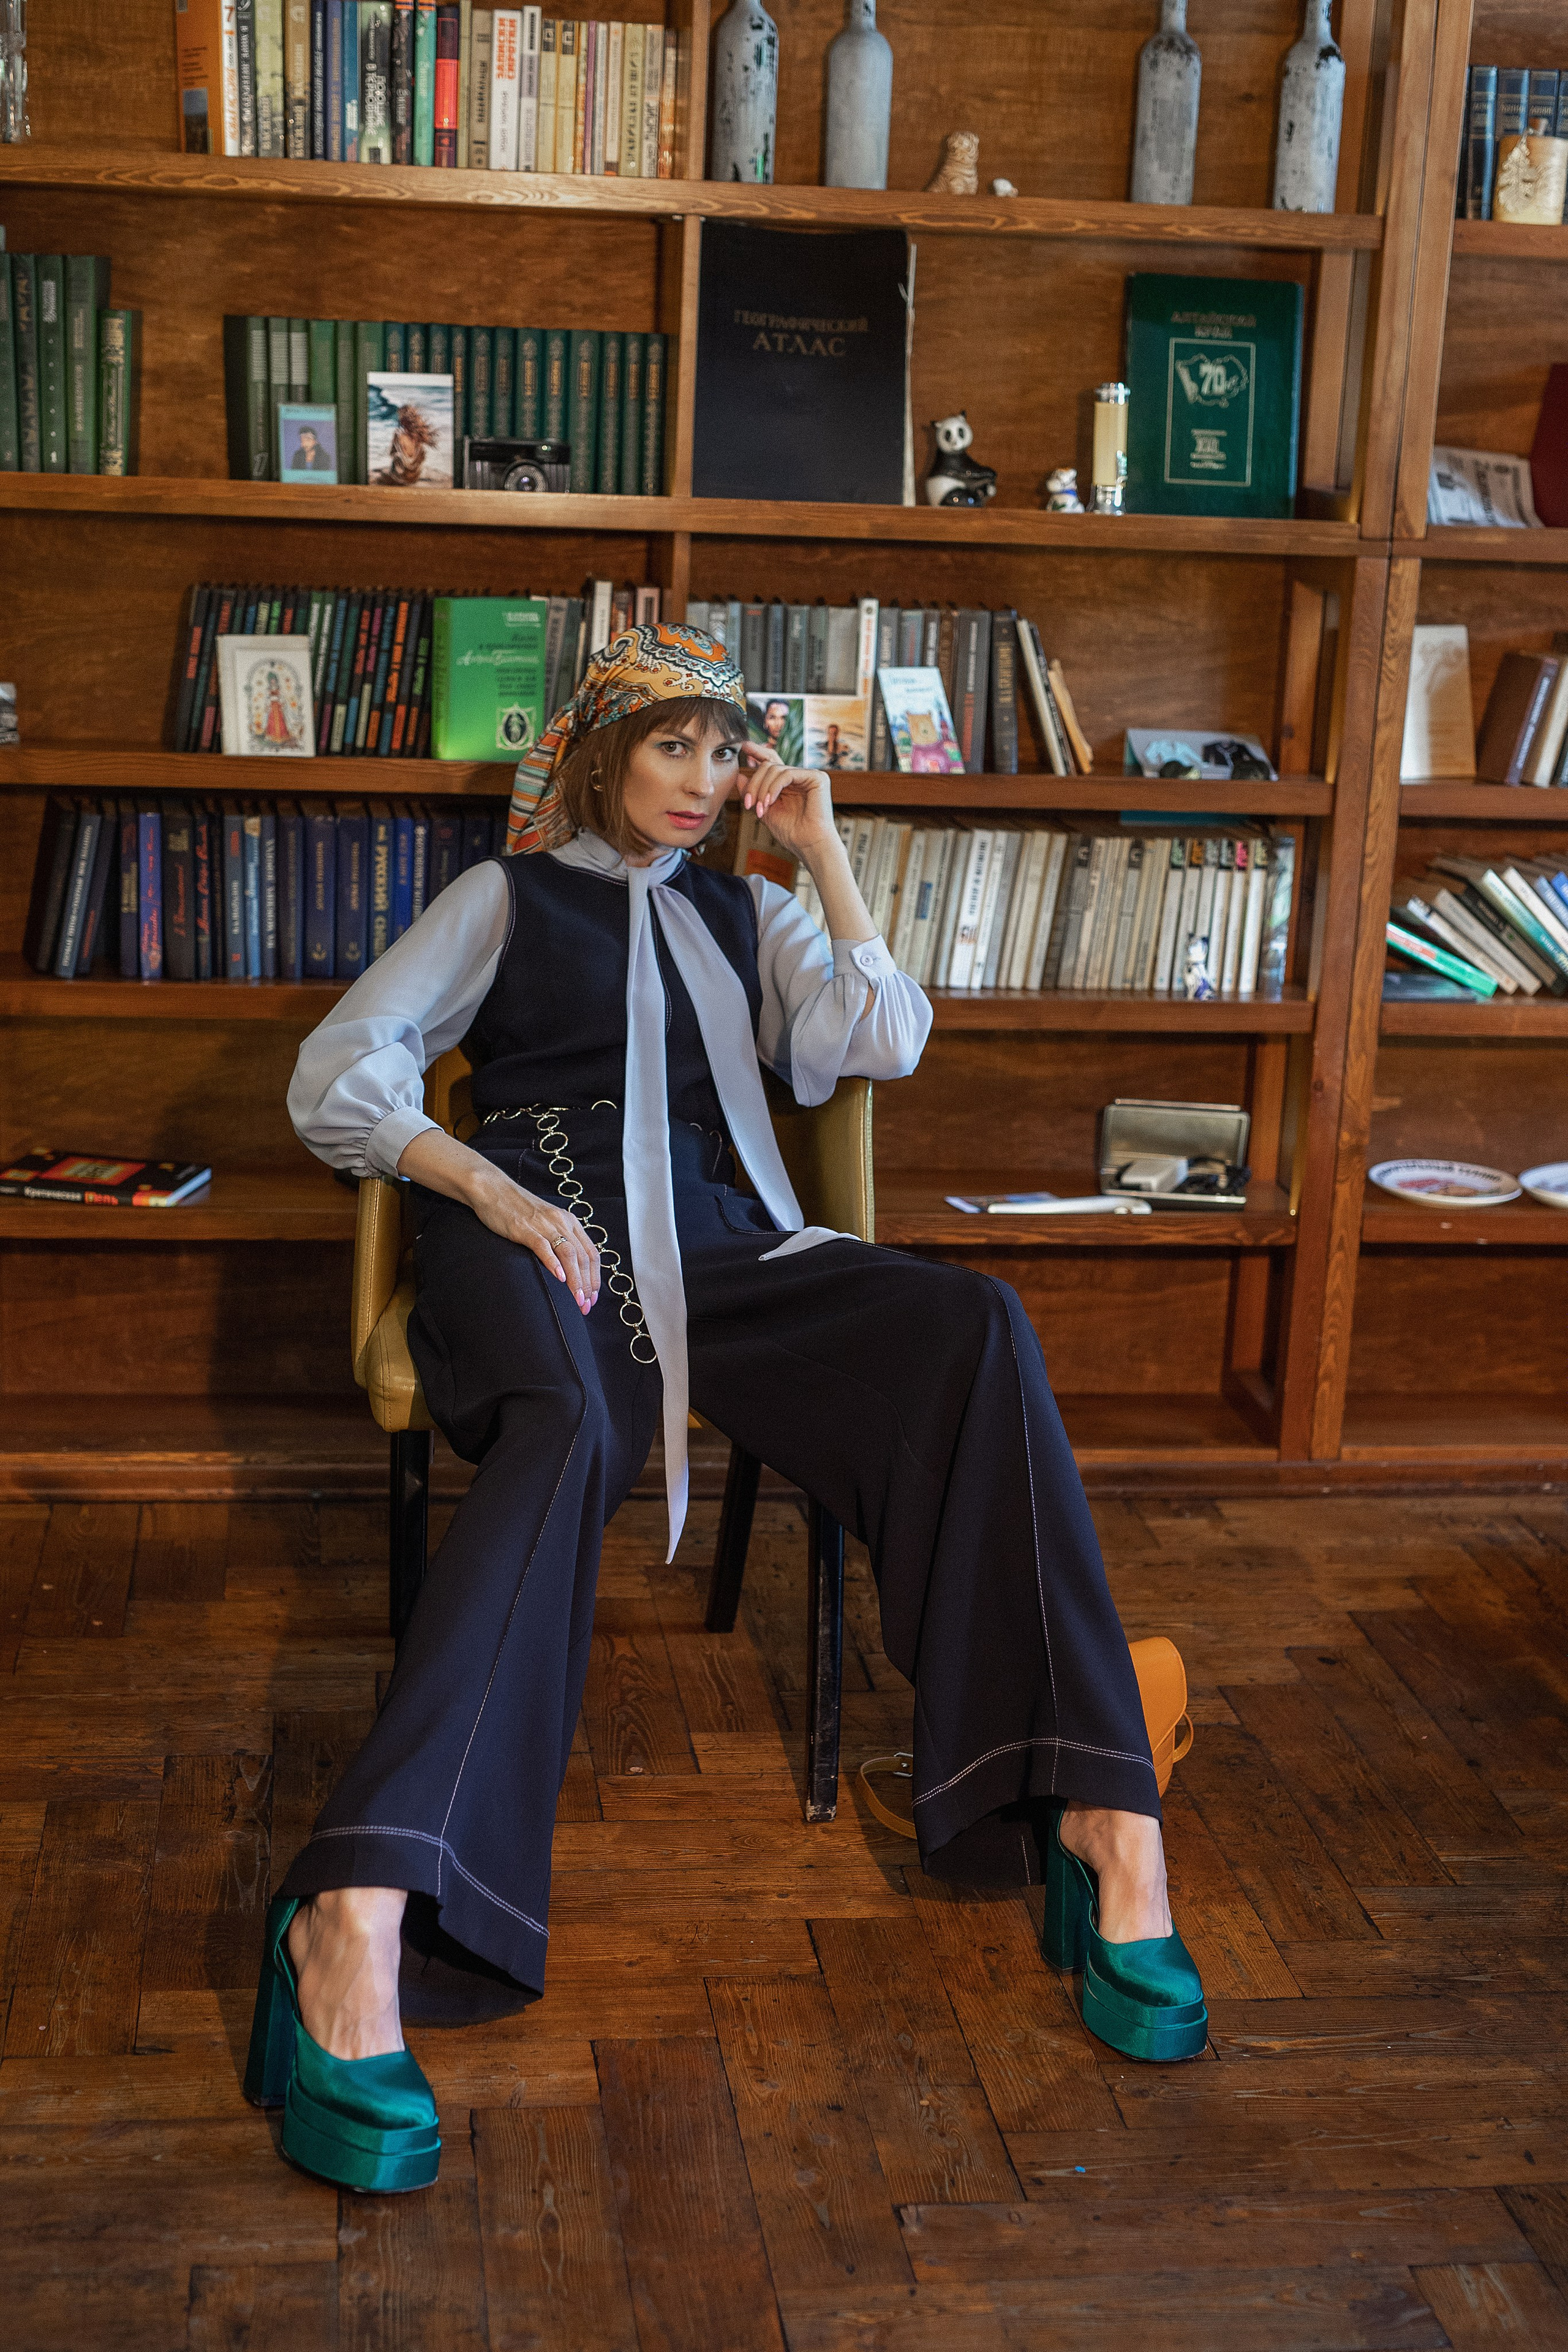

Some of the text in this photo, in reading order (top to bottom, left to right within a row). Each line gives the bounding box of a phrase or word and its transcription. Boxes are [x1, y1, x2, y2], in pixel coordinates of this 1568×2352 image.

[496, 17, 506, 80] ЗАПИСКИ
[507, 18, 518, 80] СИРОТКИ
[752, 331, 846, 356] АТЛАС
[1199, 364, 1226, 396] 70
